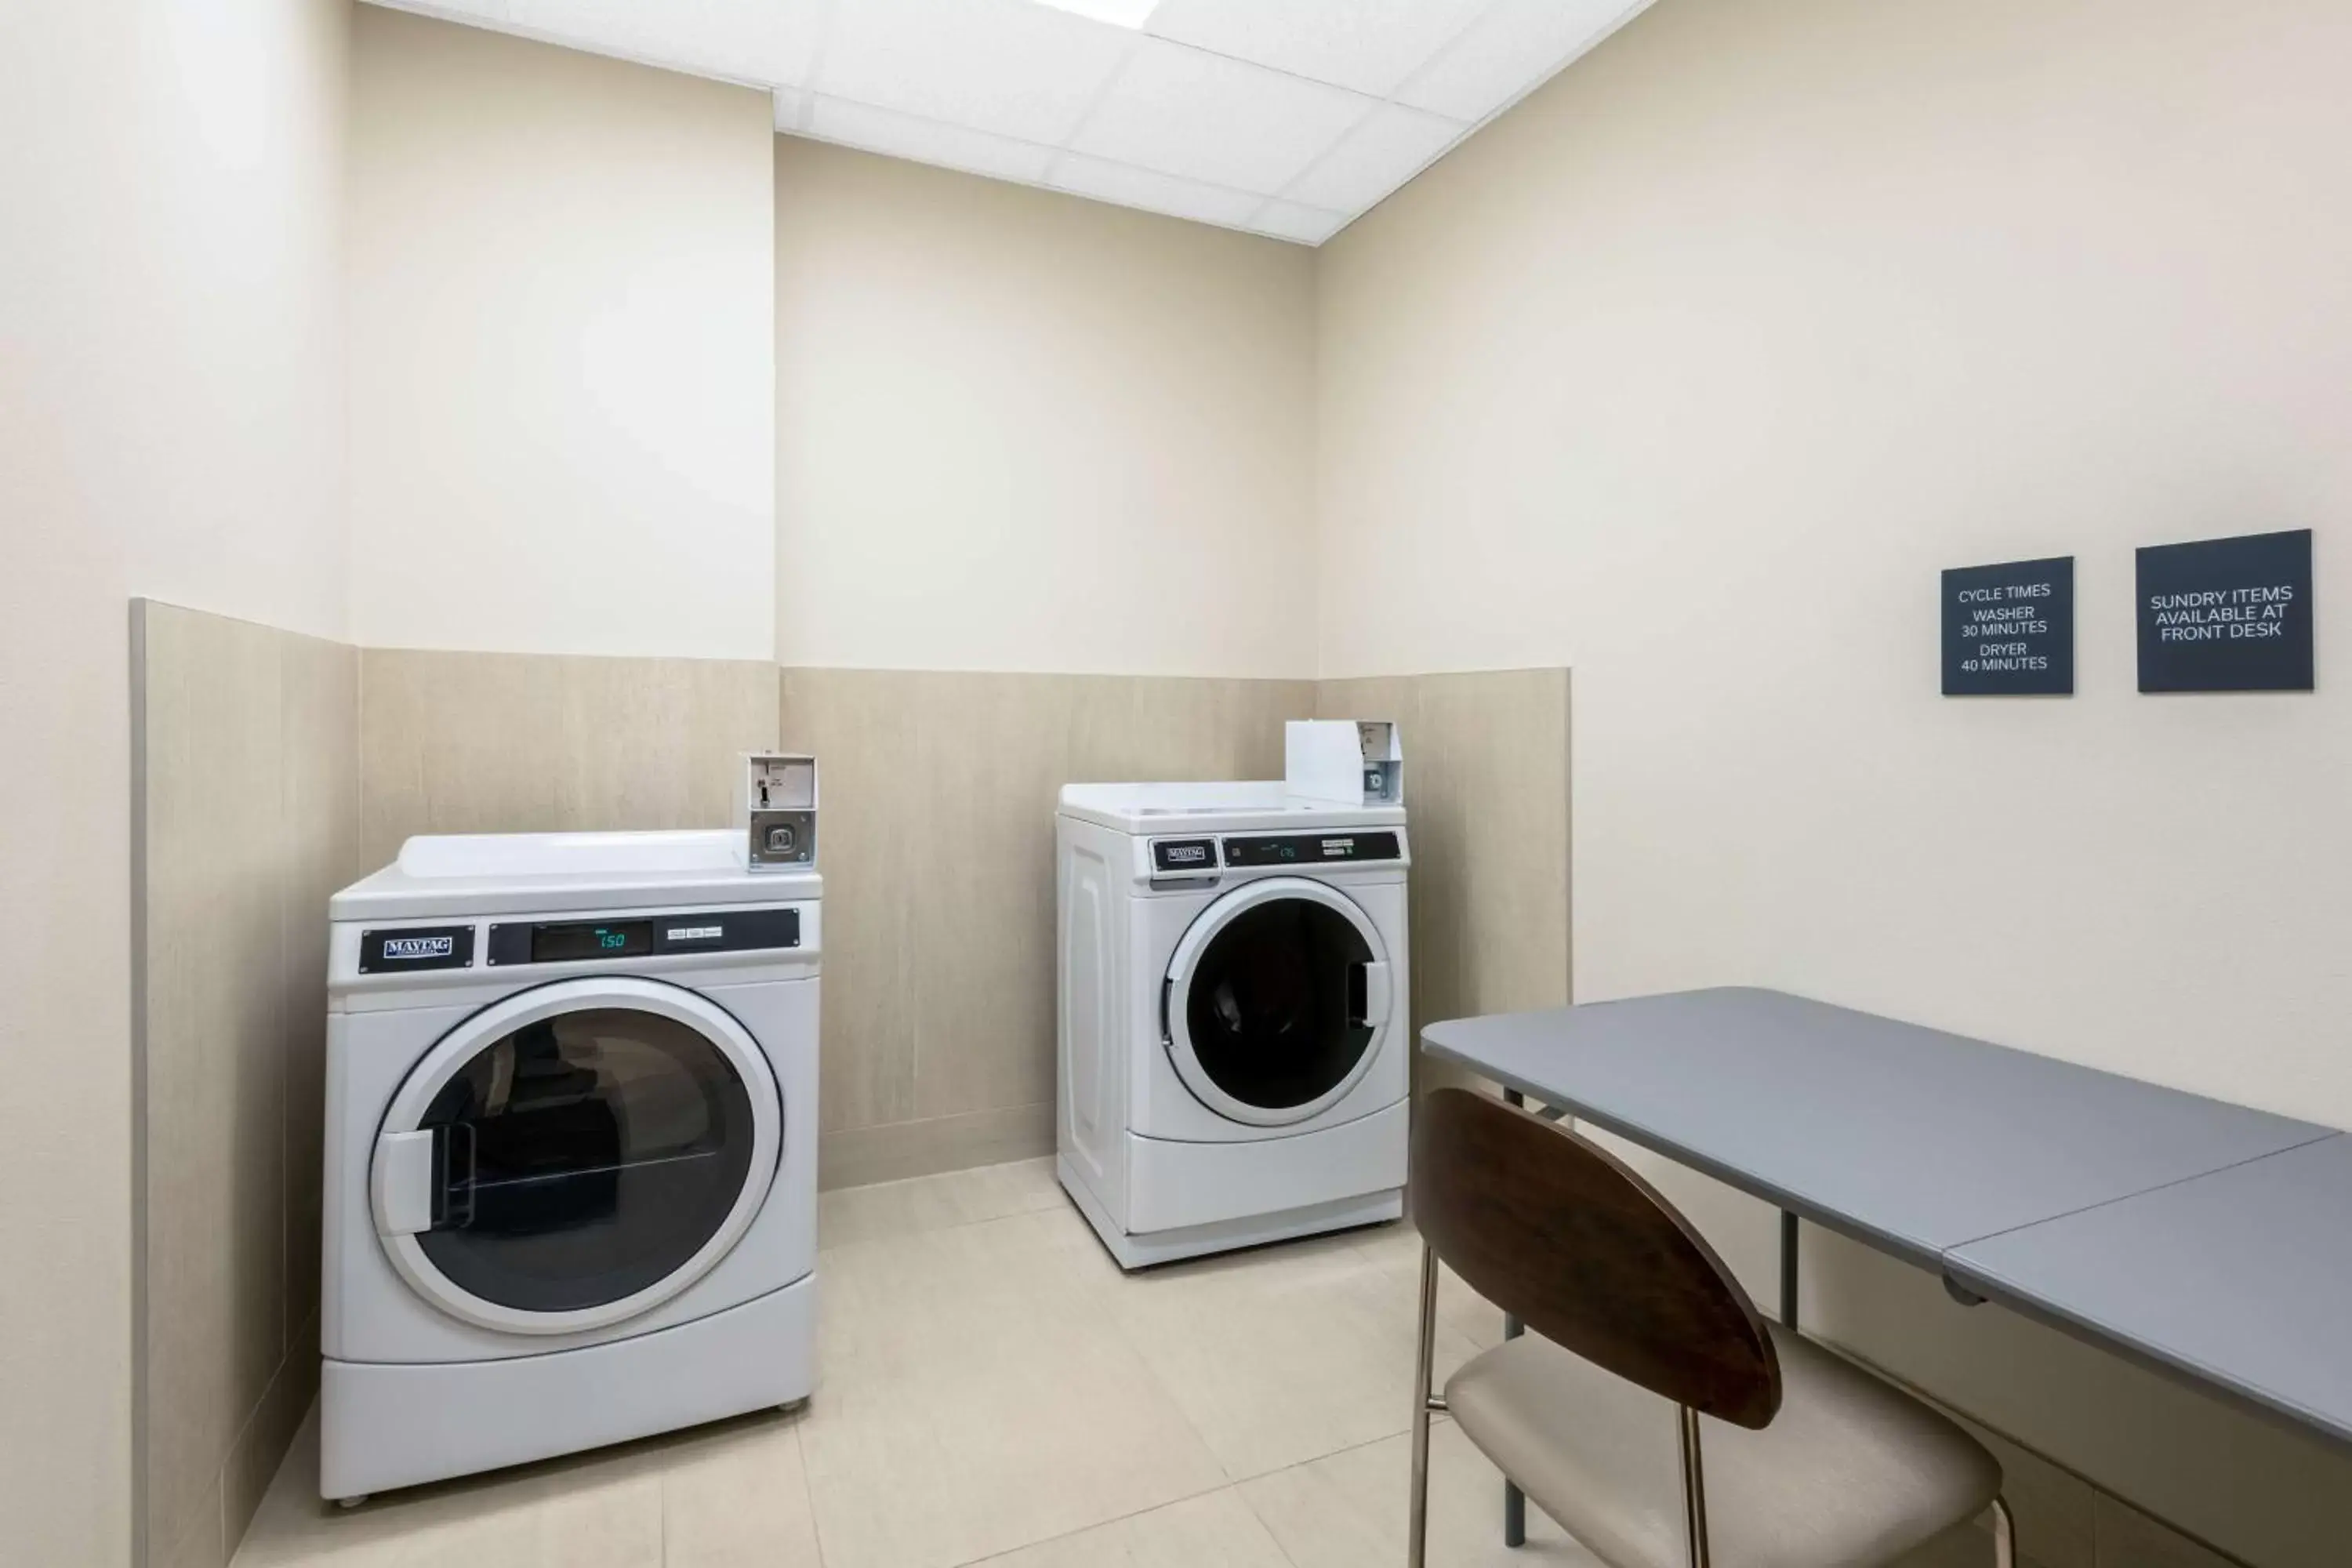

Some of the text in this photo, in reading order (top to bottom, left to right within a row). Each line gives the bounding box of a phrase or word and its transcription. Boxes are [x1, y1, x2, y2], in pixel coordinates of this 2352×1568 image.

[1958, 583, 2051, 603] CYCLE TIMES
[2151, 586, 2293, 609] SUNDRY ITEMS
[1973, 606, 2034, 622] WASHER
[2156, 603, 2288, 626] AVAILABLE AT
[1962, 620, 2048, 637] 30 MINUTES
[2161, 621, 2281, 641] FRONT DESK
[1980, 642, 2027, 656] DRYER
[1961, 656, 2048, 671] 40 MINUTES
[387, 940, 448, 952] MAYTAG
